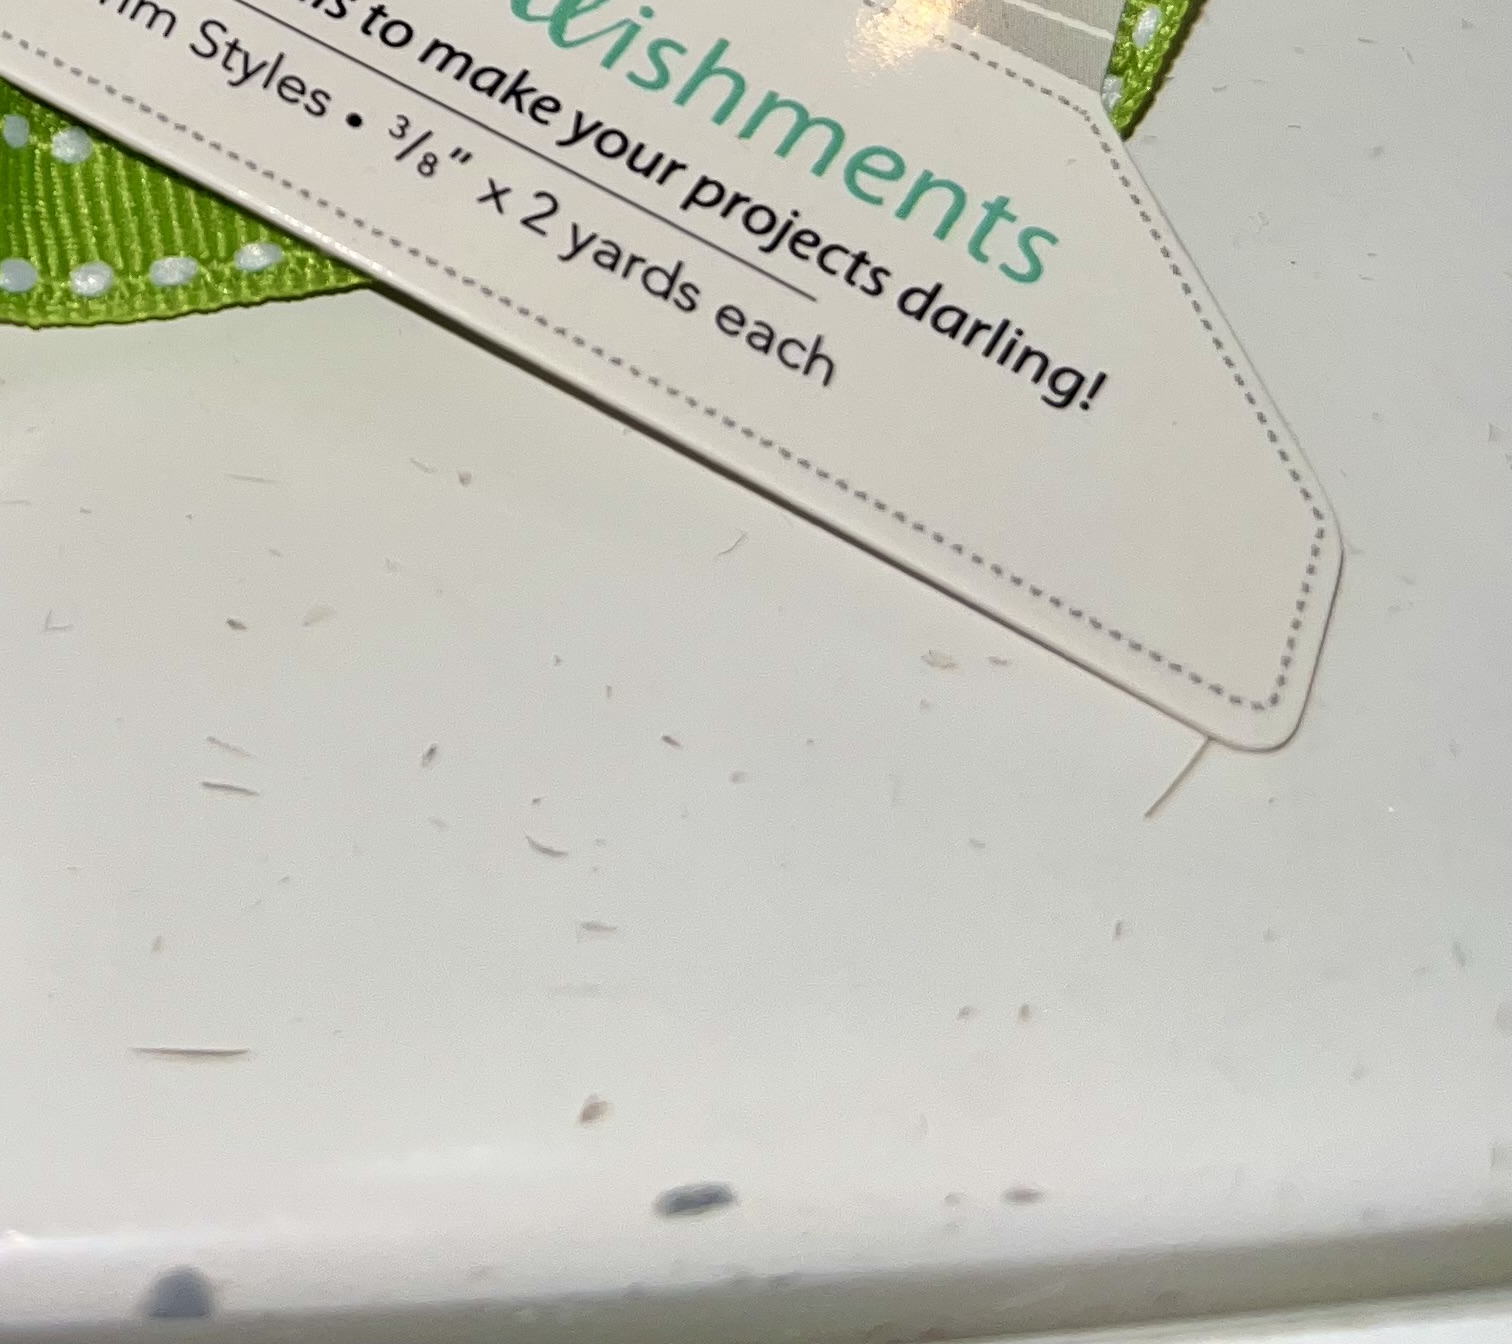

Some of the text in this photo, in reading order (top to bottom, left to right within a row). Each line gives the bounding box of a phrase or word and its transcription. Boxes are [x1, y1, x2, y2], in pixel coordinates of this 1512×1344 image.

[189, 18, 332, 118] Styles
[477, 179, 512, 215] x
[520, 191, 560, 237] 2
[559, 221, 701, 313] yards
[714, 303, 837, 389] each
[361, 4, 415, 49] to
[418, 38, 563, 127] make
[555, 109, 688, 187] your
[679, 174, 892, 298] projects
[896, 282, 1108, 412] darling!
